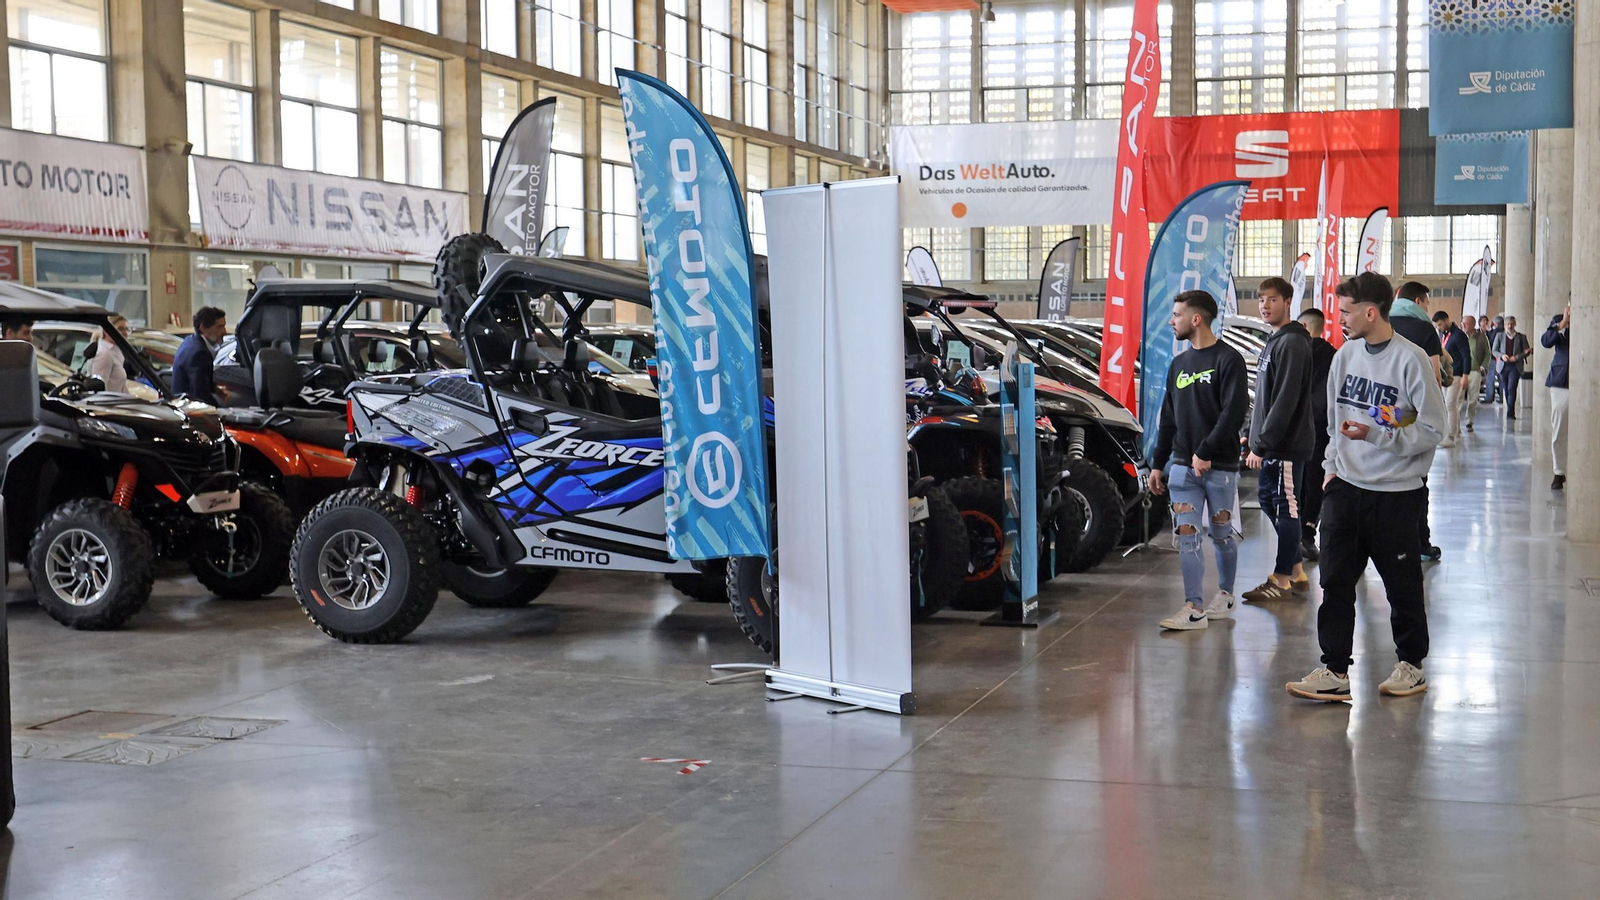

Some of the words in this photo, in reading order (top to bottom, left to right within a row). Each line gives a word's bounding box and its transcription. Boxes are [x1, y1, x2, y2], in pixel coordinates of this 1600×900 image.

[1495, 68, 1545, 81] Diputación
[1495, 83, 1507, 93] de
[1510, 81, 1536, 92] Cádiz
[919, 165, 956, 181] Das
[960, 163, 1056, 180] WeltAuto.
[41, 164, 131, 200] MOTOR
[955, 186, 965, 194] de
[966, 185, 996, 194] Ocasión
[997, 186, 1007, 194] de
[1008, 184, 1037, 193] calidad
[211, 190, 256, 205] NISSAN
[528, 164, 541, 219] MOTOR
[1241, 187, 1306, 203] EAT
[267, 177, 450, 241] NISSAN
[1340, 374, 1399, 406] GIANTS
[408, 395, 430, 406] LIMITED
[430, 400, 451, 411] EDITION
[530, 546, 610, 565] CFMOTO
